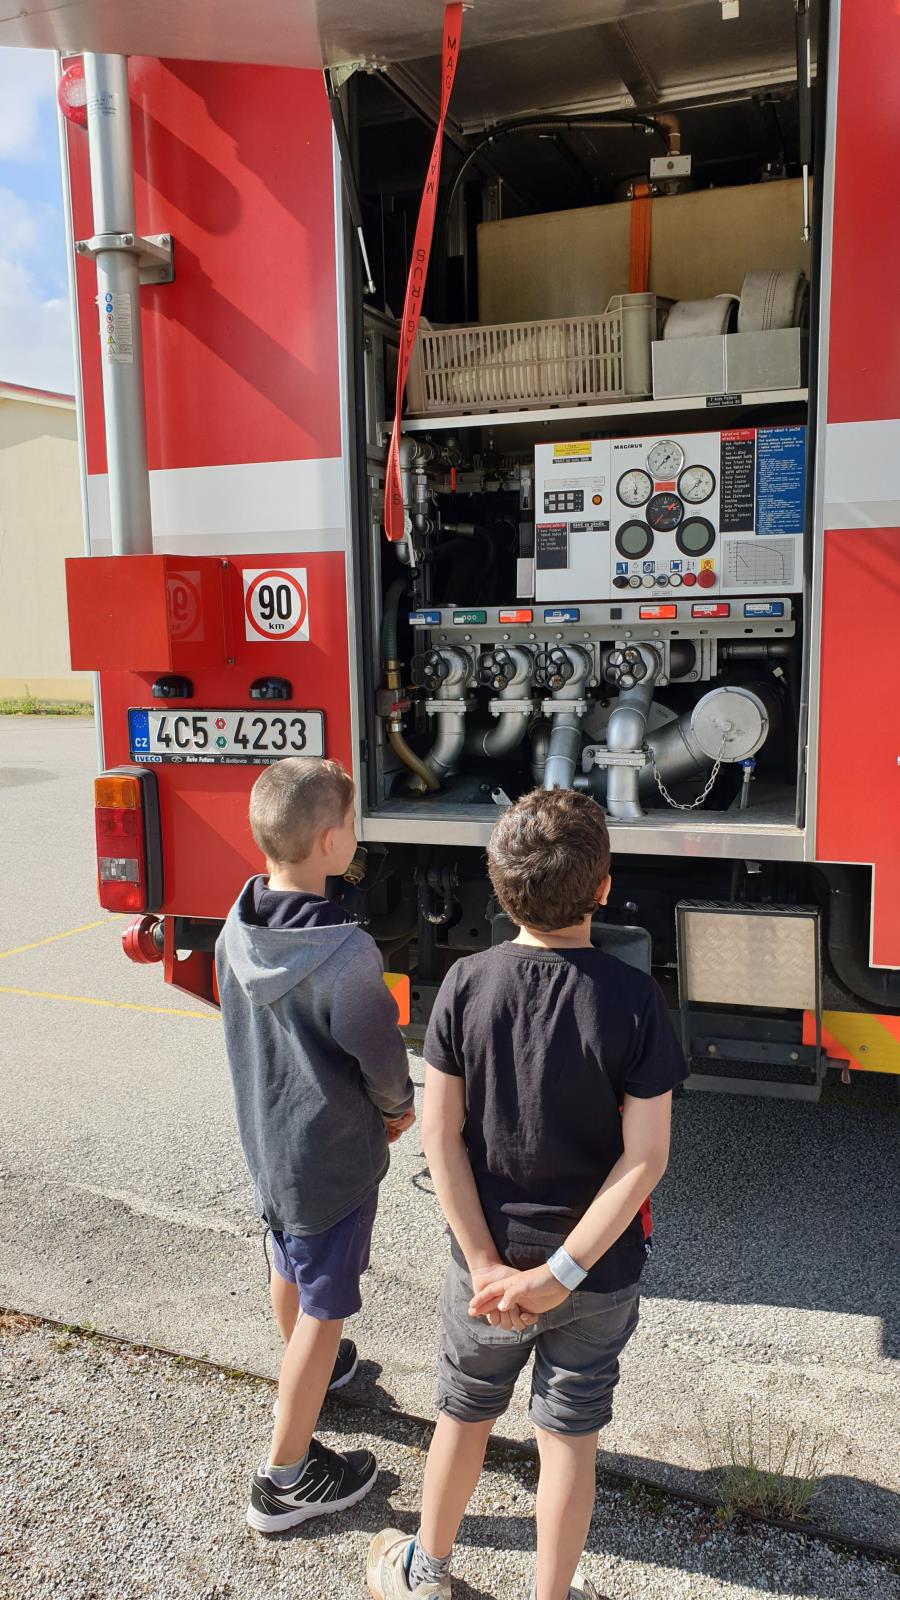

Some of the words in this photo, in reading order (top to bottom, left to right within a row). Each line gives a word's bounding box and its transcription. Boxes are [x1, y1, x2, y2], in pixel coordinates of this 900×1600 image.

[403, 248, 426, 368] MAGIRUS
[258, 584, 292, 620] 90
[268, 622, 285, 630] km
[156, 716, 209, 749] 4C5
[233, 716, 307, 751] 4233
[134, 737, 148, 747] CZ
[135, 755, 161, 763] IVECO
[186, 755, 198, 763] Auto
